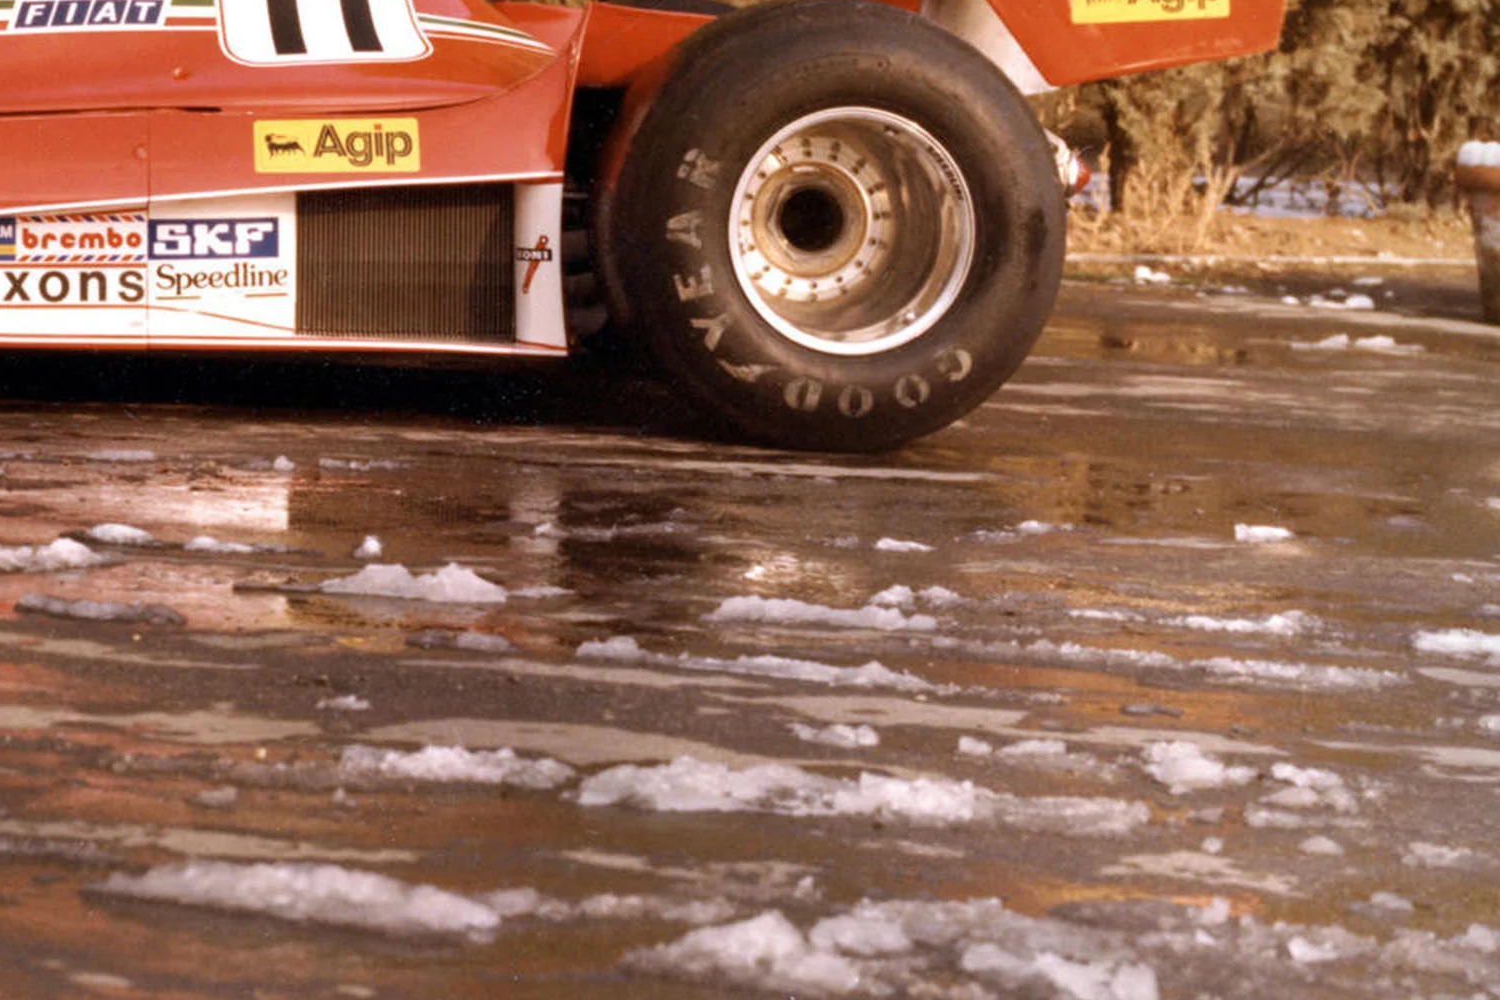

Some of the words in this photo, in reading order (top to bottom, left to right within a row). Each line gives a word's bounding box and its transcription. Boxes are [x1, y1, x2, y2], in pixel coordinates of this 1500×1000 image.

[23, 1, 157, 26] FIAT
[313, 123, 414, 167] Agip
[21, 227, 143, 250] brembo
[153, 221, 275, 257] SKF
[155, 261, 290, 296] Speedline
[783, 349, 973, 418] GOOD
